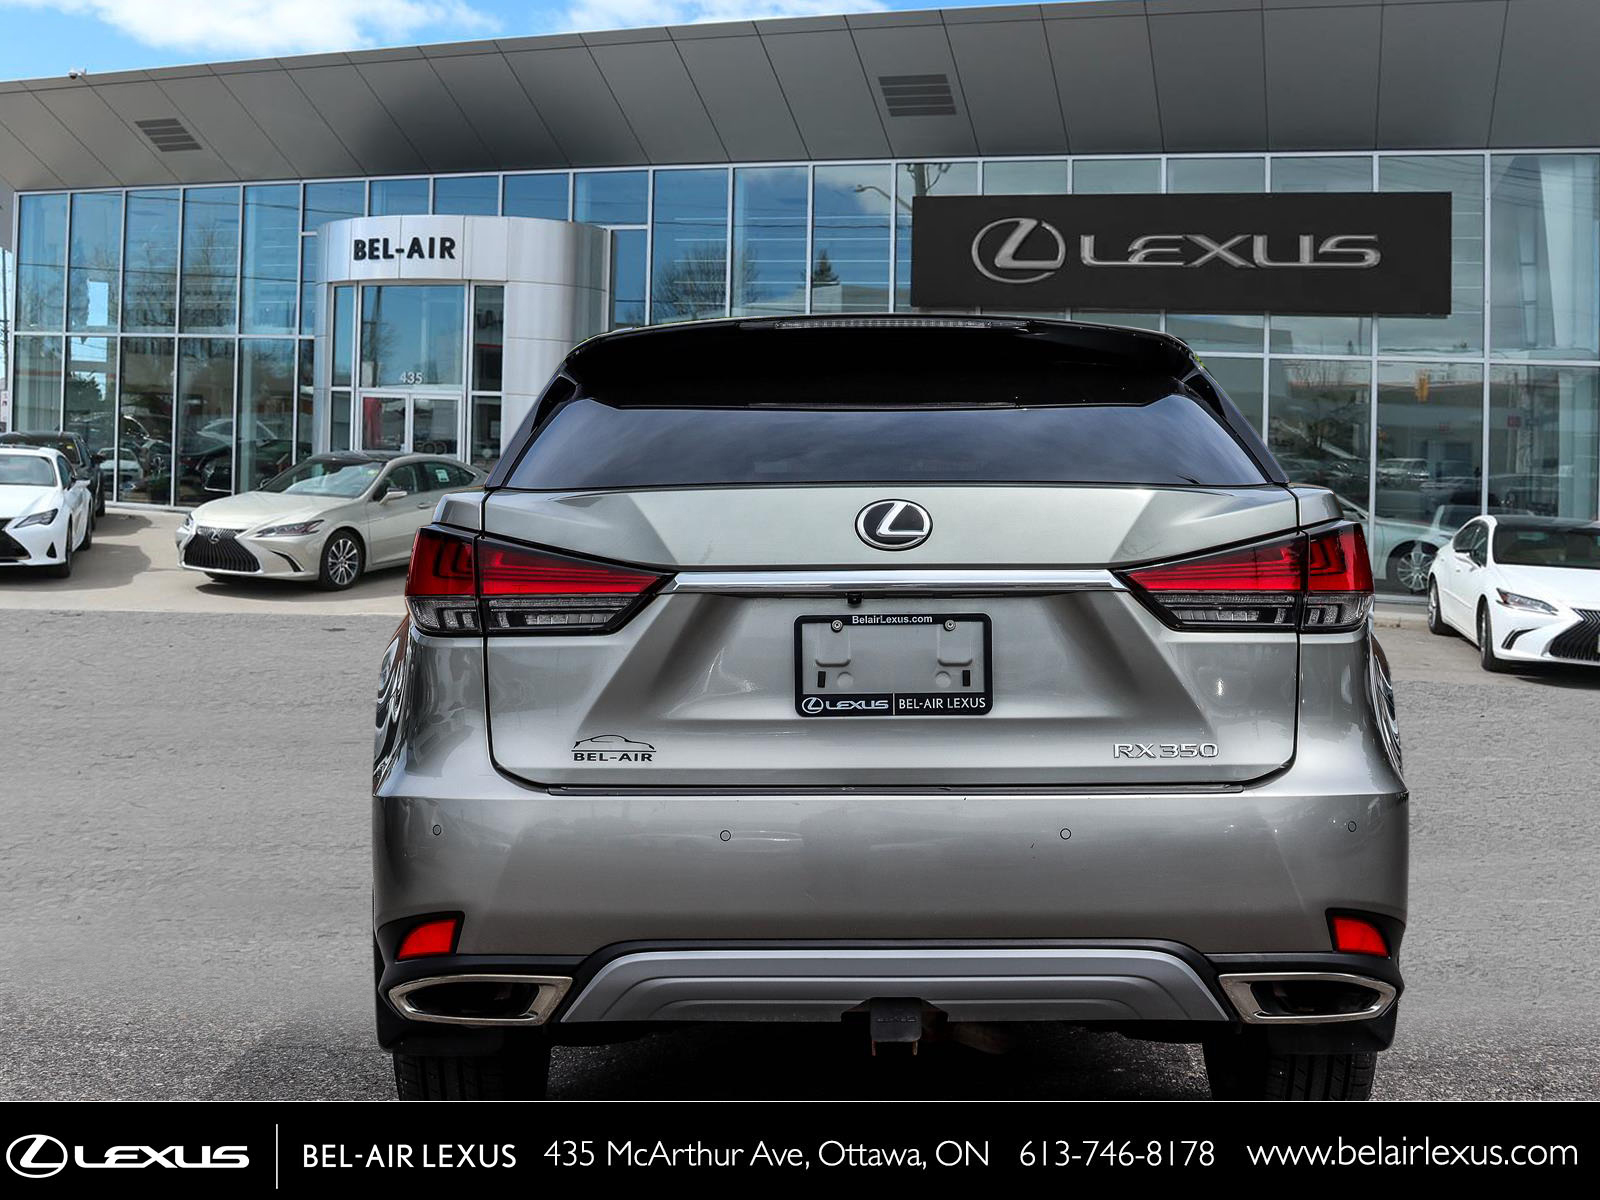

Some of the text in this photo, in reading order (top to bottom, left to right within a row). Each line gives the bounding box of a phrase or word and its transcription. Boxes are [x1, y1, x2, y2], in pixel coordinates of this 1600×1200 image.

[353, 236, 456, 261] BEL-AIR
[1080, 234, 1381, 269] LEXUS
[401, 371, 423, 384] 435
[852, 615, 933, 624] BelairLexus.com
[825, 700, 889, 710] LEXUS
[899, 697, 986, 709] BEL-AIR LEXUS
[573, 752, 653, 762] BEL-AIR
